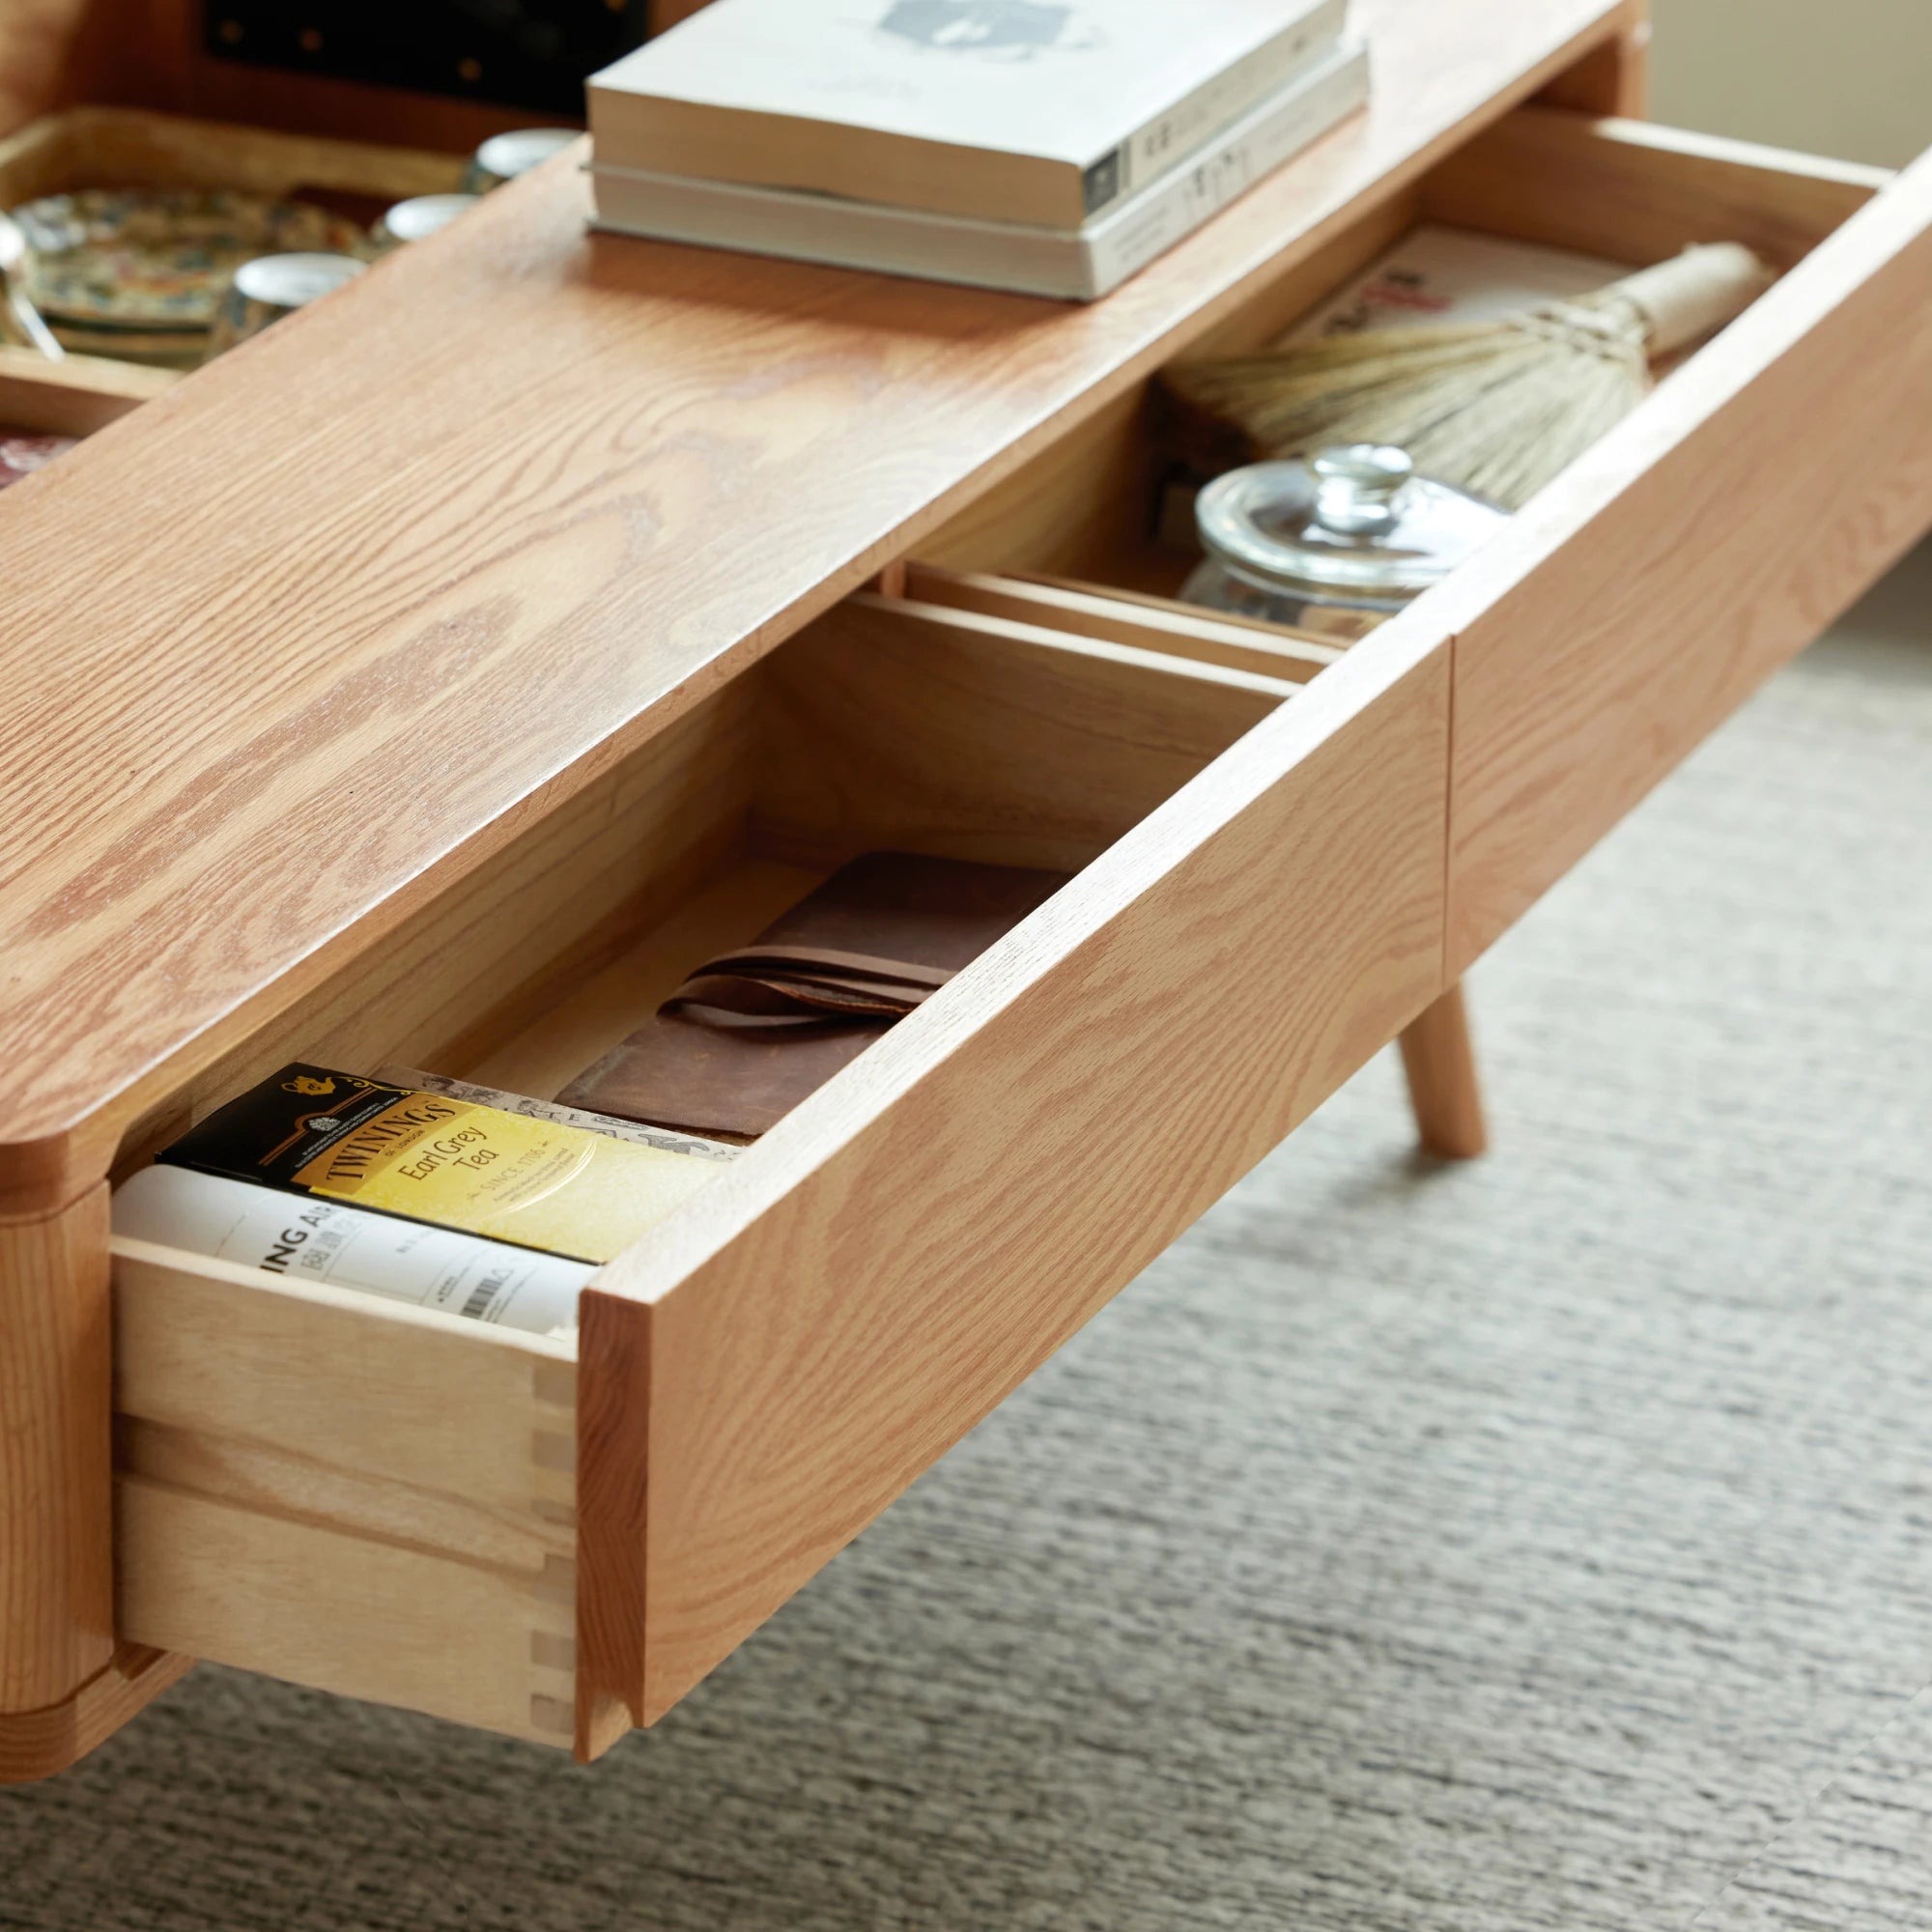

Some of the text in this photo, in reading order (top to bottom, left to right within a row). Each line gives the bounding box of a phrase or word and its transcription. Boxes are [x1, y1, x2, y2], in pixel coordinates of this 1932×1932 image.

[326, 1103, 456, 1179] TWININGS
[398, 1151, 448, 1180] Earl
[433, 1126, 487, 1154] Grey
[452, 1149, 500, 1171] Tea
[480, 1166, 524, 1190] SINCE
[518, 1148, 546, 1166] 1706
[259, 1228, 309, 1274] ING
